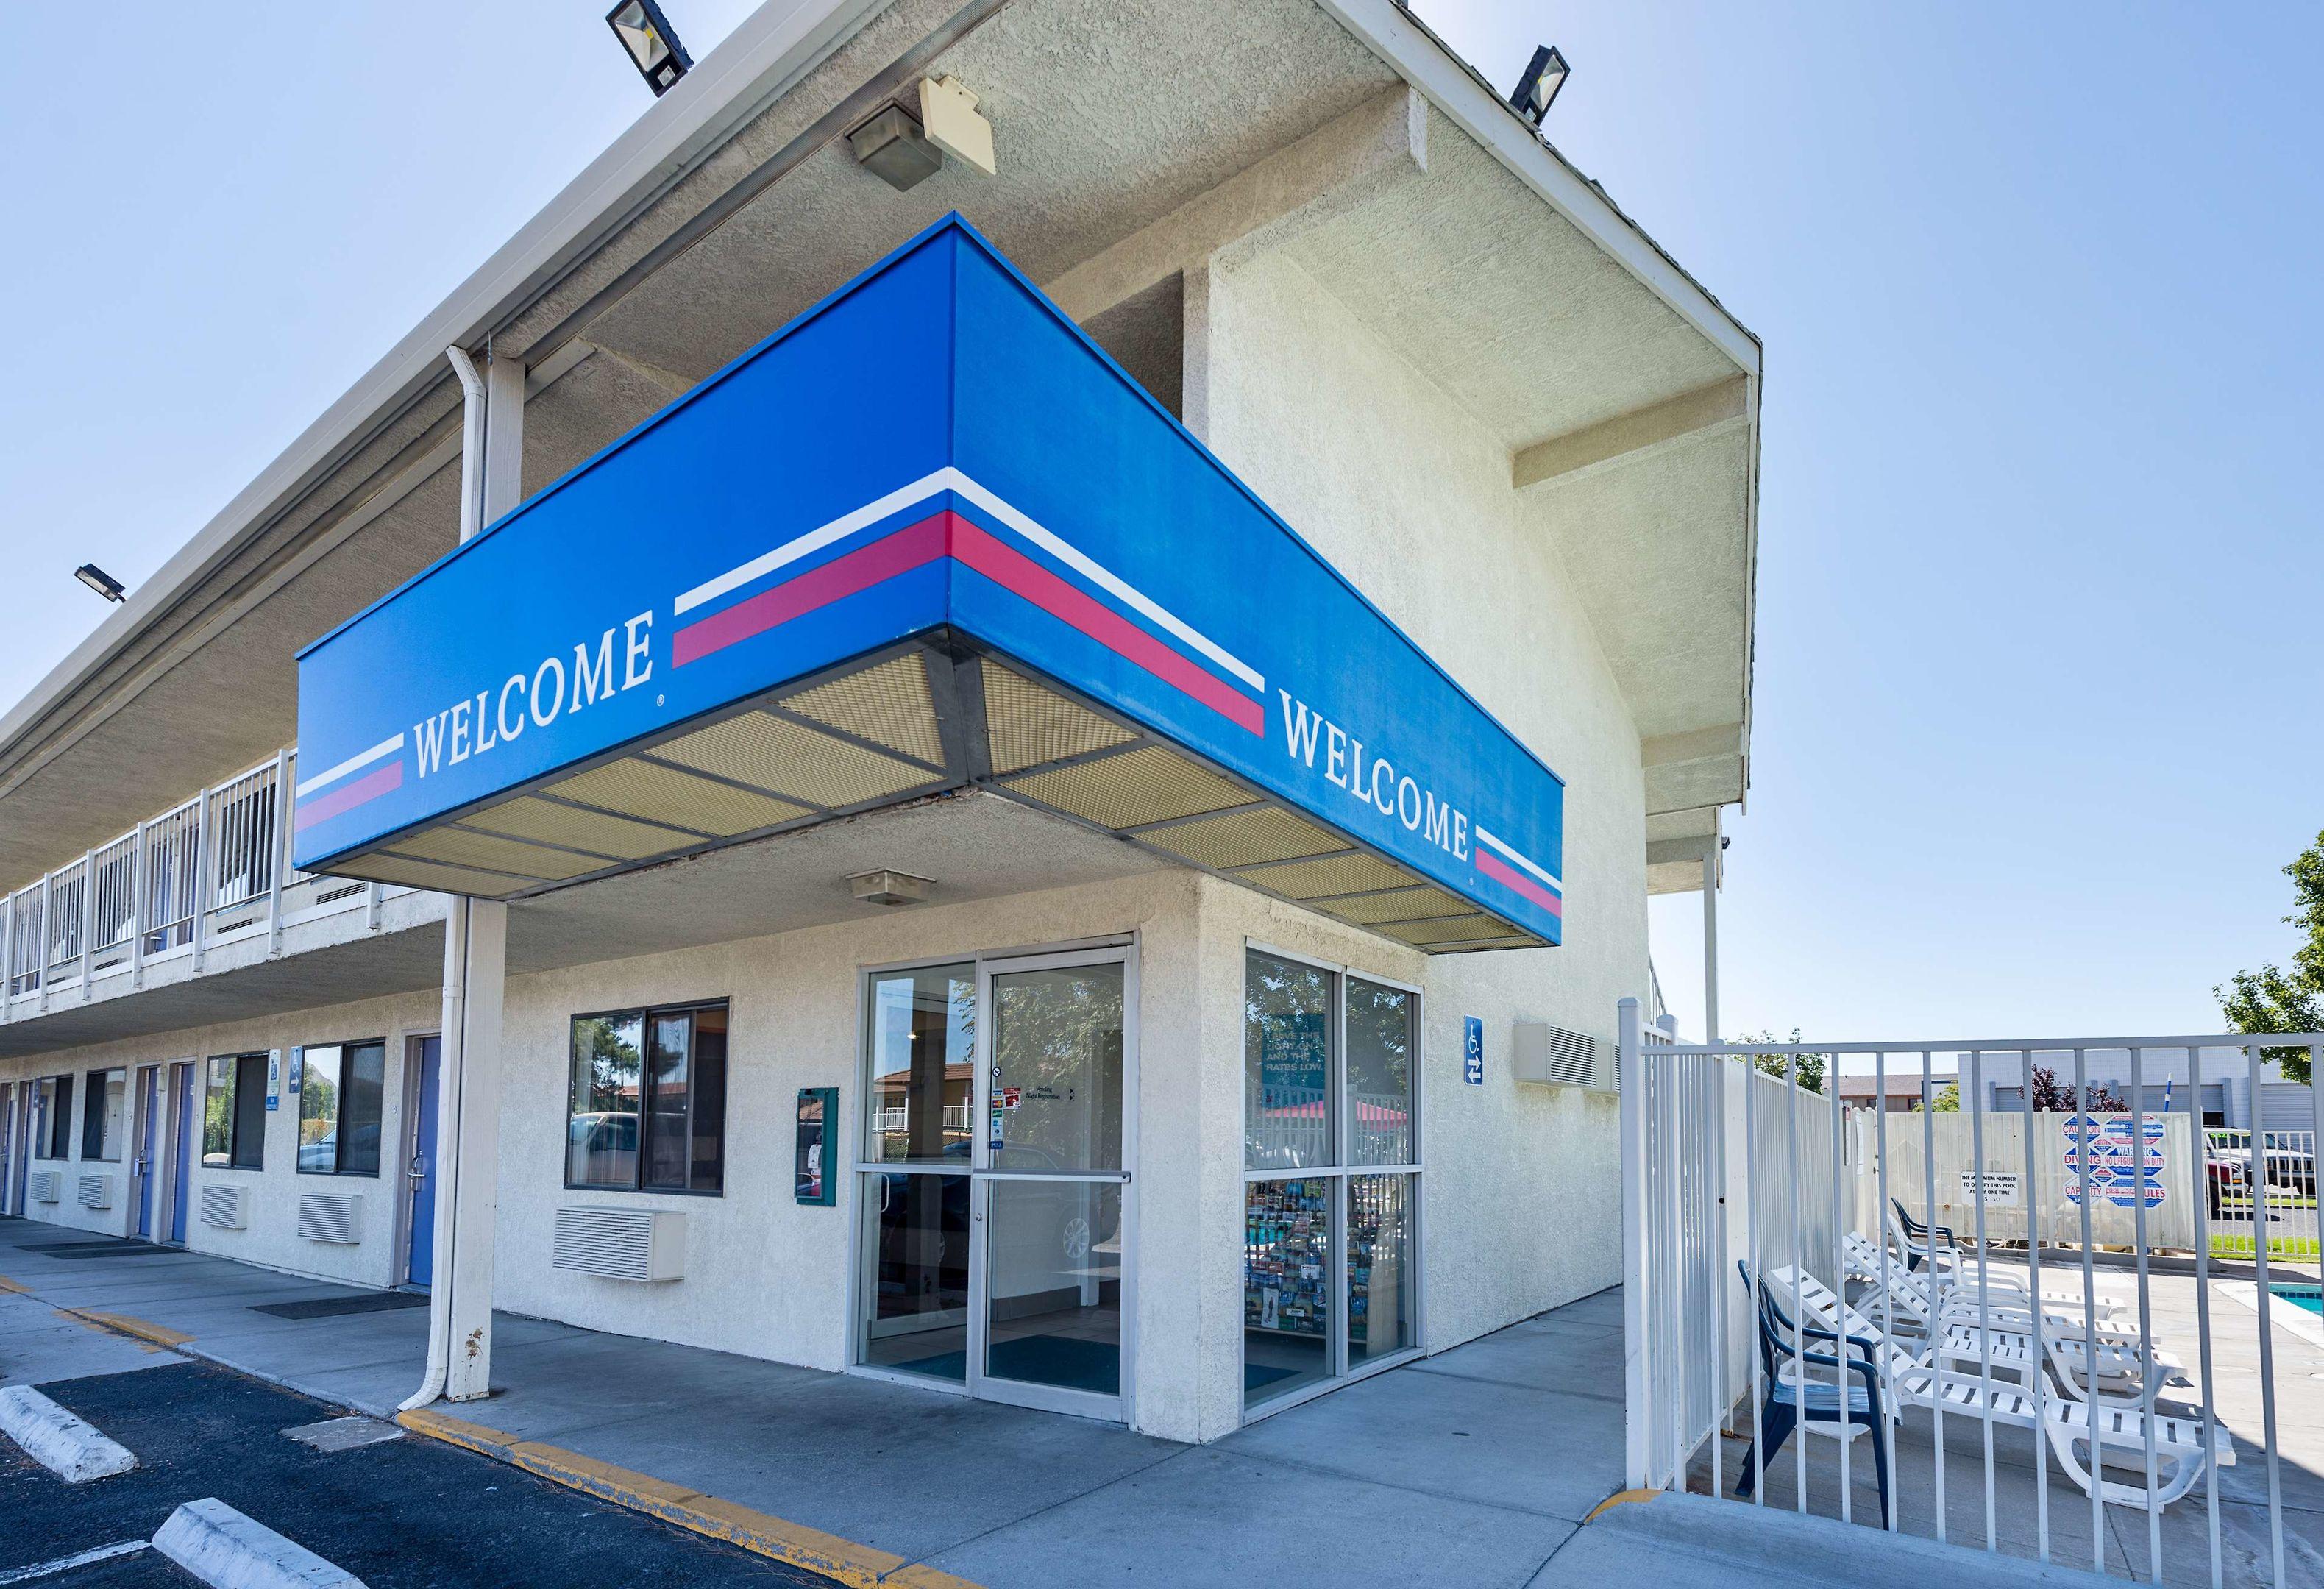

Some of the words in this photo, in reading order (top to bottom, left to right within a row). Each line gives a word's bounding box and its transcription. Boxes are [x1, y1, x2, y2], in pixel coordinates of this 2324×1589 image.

[413, 609, 653, 778] WELCOME
[1279, 687, 1468, 862] WELCOME
[1266, 1063, 1297, 1071] RATES
[2117, 1148, 2153, 1156] WARNG
[2064, 1156, 2101, 1164] DIVNG
[2105, 1156, 2112, 1165] NO
[2114, 1156, 2136, 1165] LIFEGUA
[2151, 1157, 2165, 1166] DUTY
[2065, 1186, 2102, 1196] CAPITY
[2142, 1189, 2166, 1198] ULES
